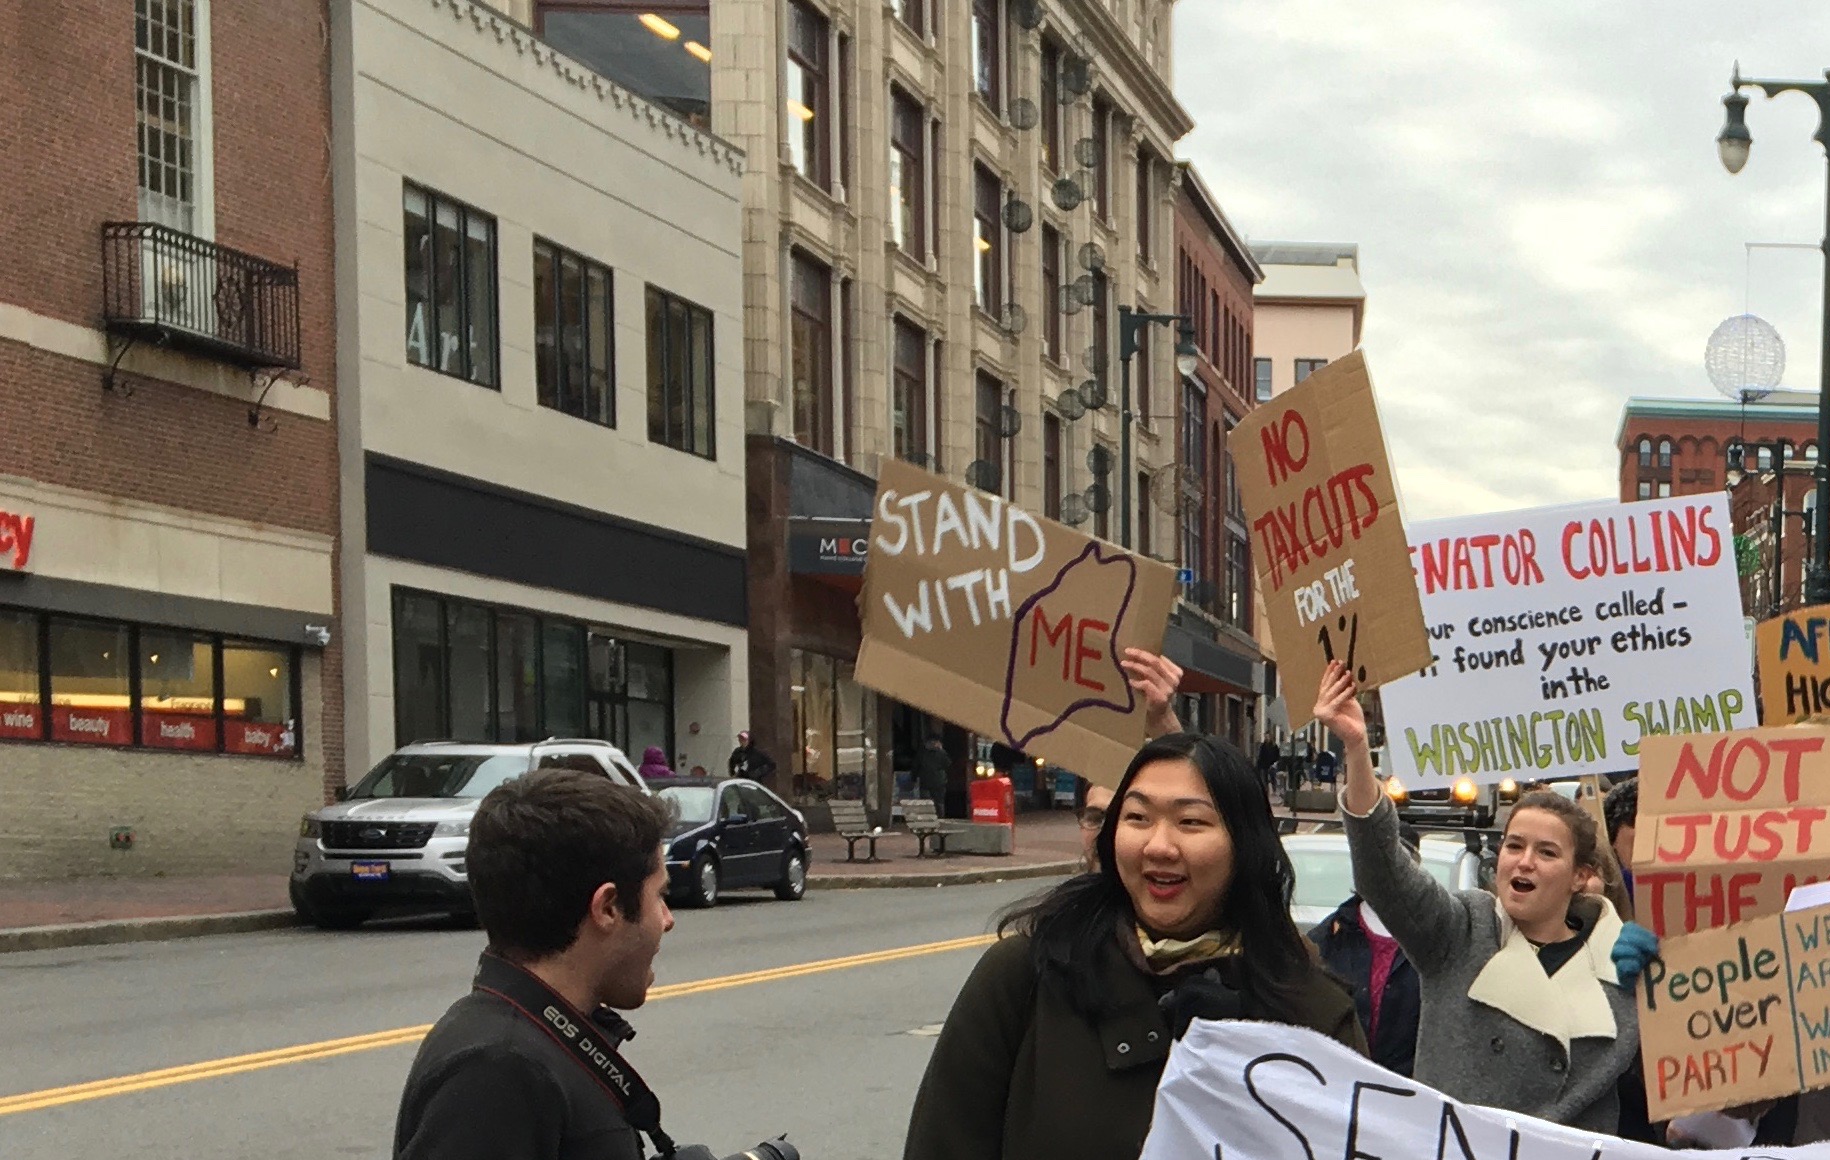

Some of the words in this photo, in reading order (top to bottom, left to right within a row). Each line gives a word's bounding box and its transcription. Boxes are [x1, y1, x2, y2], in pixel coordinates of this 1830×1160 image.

[1261, 409, 1310, 487] NO
[876, 489, 1045, 572] STAND
[1408, 528, 1545, 594] NATOR
[1562, 505, 1721, 583] COLLINS
[884, 569, 1011, 638] WITH
[1294, 580, 1332, 627] FOR
[1324, 558, 1360, 608] THE
[1468, 605, 1583, 637] conscience
[1596, 587, 1665, 621] called
[1030, 606, 1109, 691] ME
[1453, 638, 1525, 673] found
[1538, 635, 1602, 672] your
[1611, 623, 1692, 653] ethics
[1566, 666, 1610, 695] the
[3, 709, 34, 728] wine
[69, 713, 111, 737] beauty
[1405, 708, 1606, 778] WASHINGTON
[1621, 688, 1743, 756] SWAMP
[1666, 737, 1824, 802] NOT
[1658, 808, 1826, 863] JUST
[1636, 872, 1762, 938] THE
[1642, 937, 1780, 1010] People
[543, 1005, 579, 1038] EOS
[579, 1037, 632, 1096] DIGITAL
[1687, 993, 1782, 1041] over
[1657, 1035, 1774, 1103] PARTY
